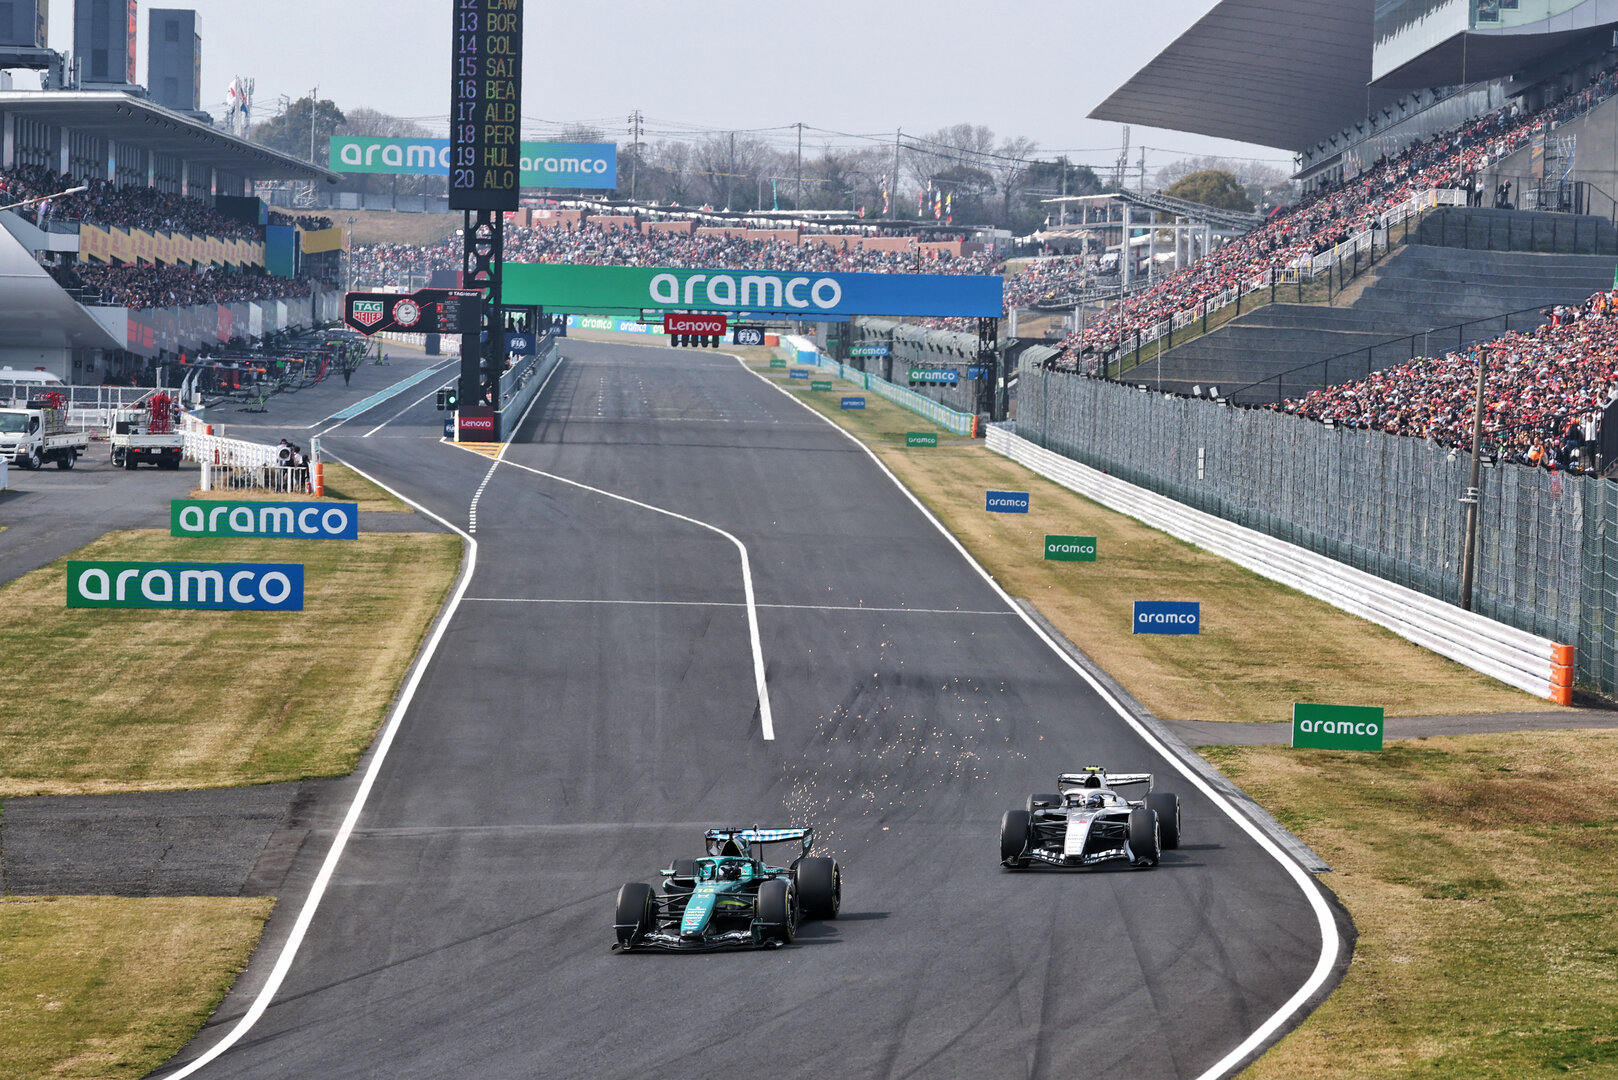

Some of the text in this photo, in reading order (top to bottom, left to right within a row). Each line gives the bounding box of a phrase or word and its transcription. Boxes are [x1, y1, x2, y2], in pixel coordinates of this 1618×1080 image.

[459, 12, 517, 33] 13 BOR
[458, 35, 516, 55] 14 COL
[458, 57, 515, 77] 15 SAI
[458, 80, 516, 100] 16 BEA
[457, 102, 516, 123] 17 ALB
[457, 125, 515, 145] 18 PER
[340, 143, 450, 168] aramc
[456, 147, 514, 167] 19 HUL
[520, 156, 608, 174] aramco
[454, 169, 514, 189] 20 ALO
[649, 273, 842, 309] aramco
[355, 303, 381, 311] TAG
[354, 312, 382, 325] HEUER
[581, 318, 613, 330] aramco
[668, 318, 722, 332] Lenovo
[620, 322, 647, 333] aramco
[511, 338, 526, 348] FIA
[740, 331, 758, 342] FIA
[851, 347, 887, 355] aramco
[911, 370, 955, 381] aramco
[461, 419, 492, 428] Lenovo
[988, 497, 1027, 507] aramco
[179, 505, 348, 534] aramco
[1048, 543, 1094, 554] aramco
[78, 567, 291, 604] aramco
[1138, 612, 1196, 624] aramco
[1300, 719, 1379, 736] aramco
